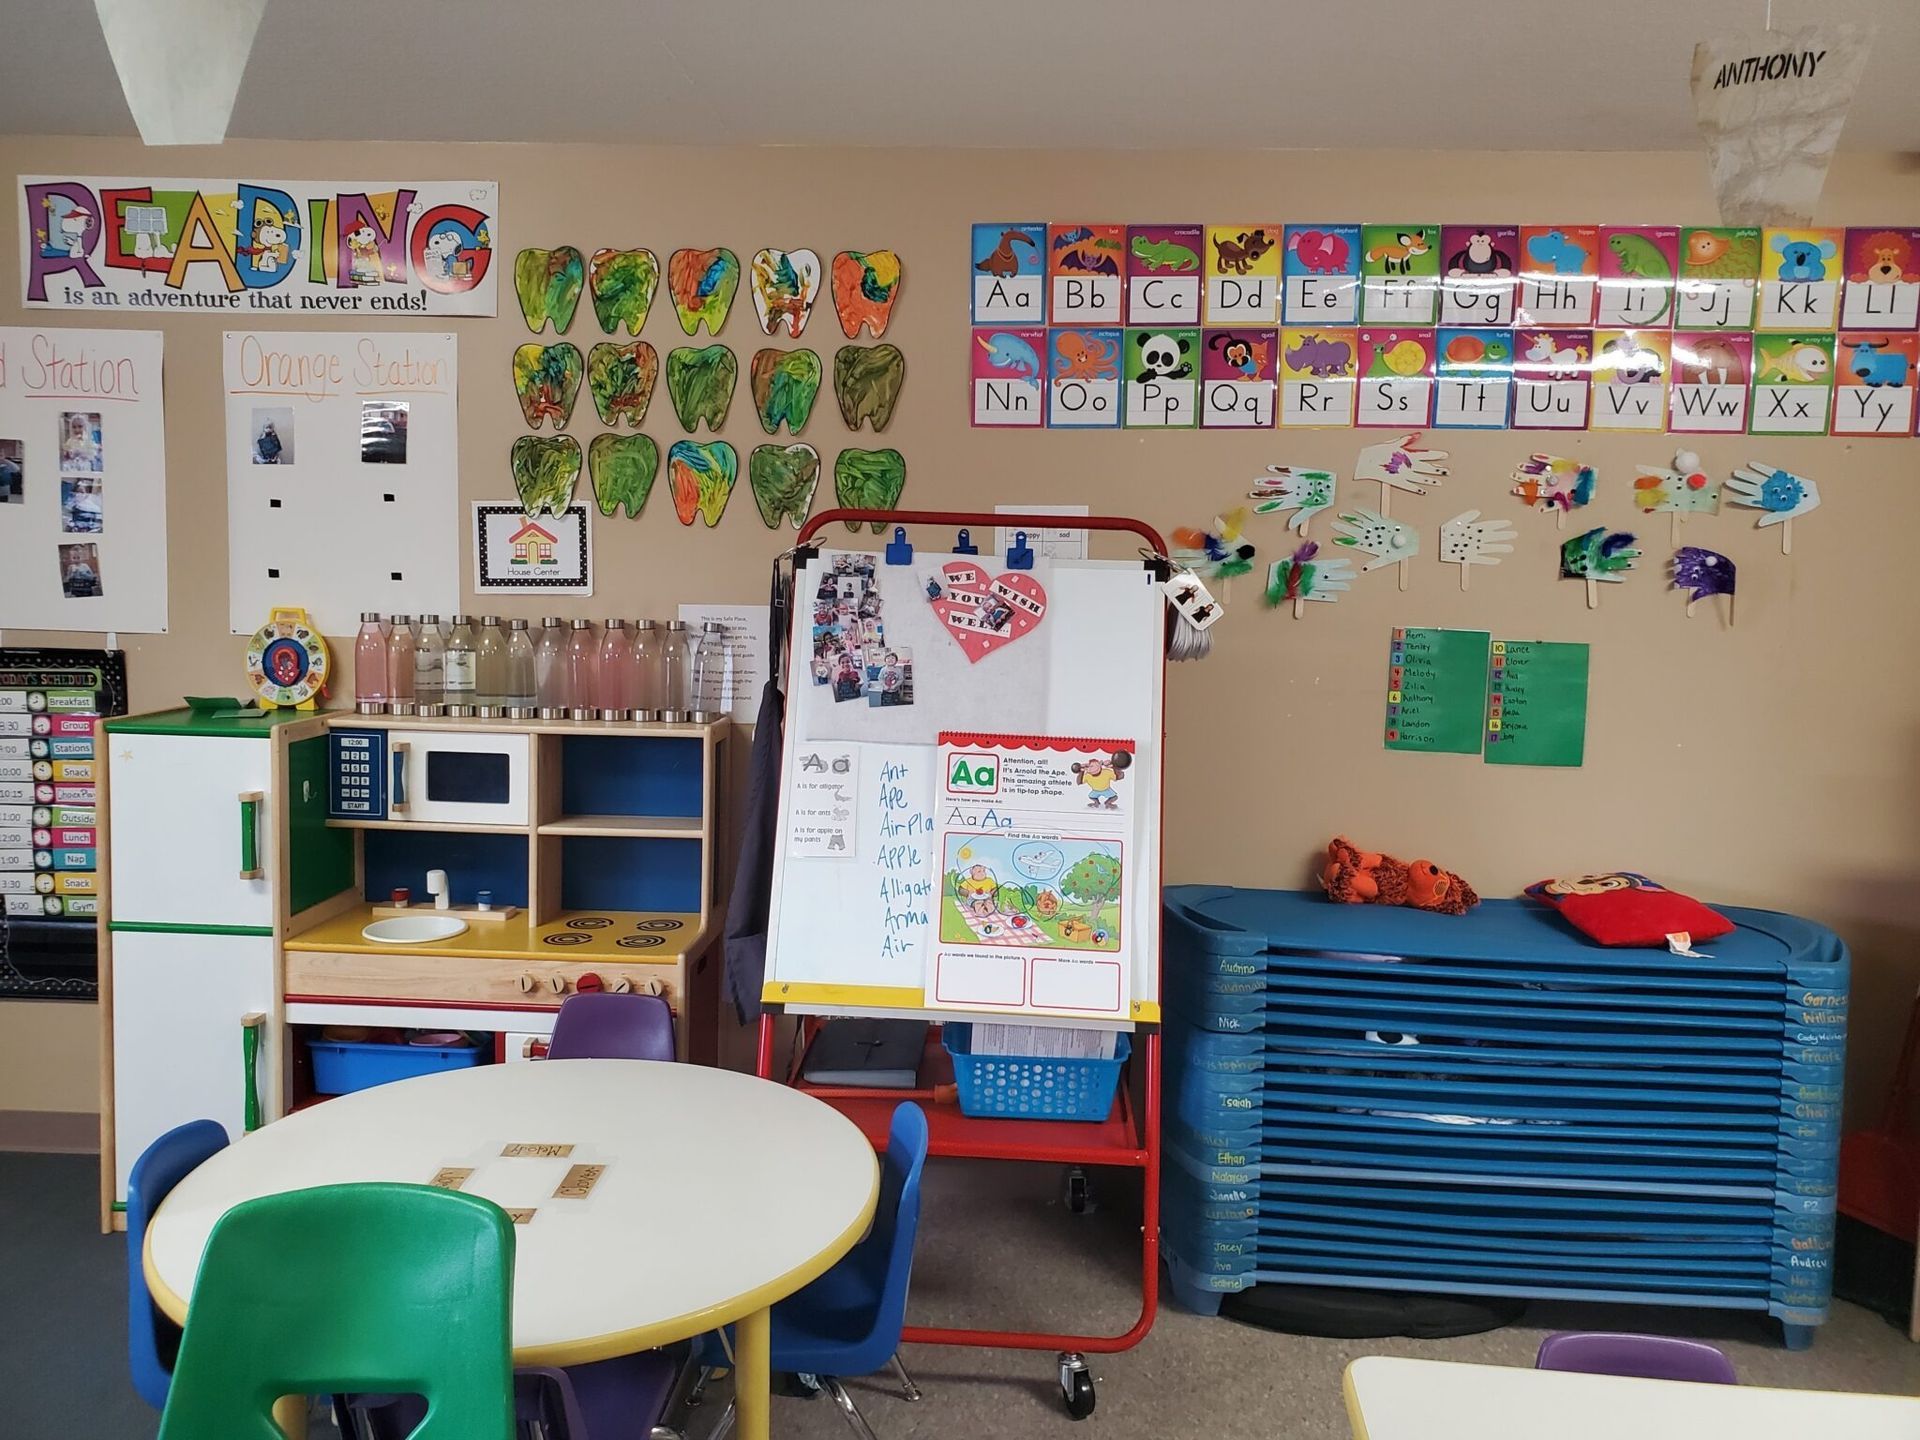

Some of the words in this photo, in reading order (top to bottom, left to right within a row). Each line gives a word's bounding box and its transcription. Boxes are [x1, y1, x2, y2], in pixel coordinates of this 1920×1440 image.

[1713, 50, 1827, 90] ANTHONY
[1333, 226, 1359, 235] elephant
[1496, 229, 1516, 238] gorilla
[25, 181, 493, 303] READING
[64, 286, 84, 305] is
[88, 290, 121, 306] an
[128, 288, 241, 309] adventure
[248, 289, 293, 310] that
[299, 294, 362, 311] never
[369, 289, 428, 311] ends!
[1020, 330, 1044, 338] narwhal
[1178, 330, 1197, 340] panda
[1260, 330, 1276, 340] quail
[1418, 331, 1432, 339] snail
[22, 334, 140, 395] Station
[239, 335, 343, 402] Orange
[353, 338, 450, 388] Station
[507, 567, 531, 576] House
[533, 567, 560, 576] Center
[948, 572, 975, 583] WE
[950, 591, 985, 605] YOU
[998, 584, 1041, 613] WISH
[1506, 643, 1530, 654] Lance
[1405, 654, 1432, 666] Olivia
[1505, 657, 1529, 666] Clover
[40, 673, 95, 685] SCHEDULE
[1403, 667, 1436, 680] Melody
[49, 698, 90, 706] Breakfast
[1402, 694, 1434, 704] Anthony
[62, 721, 90, 731] Group
[1402, 719, 1430, 728] Landon
[1400, 732, 1435, 743] Harrison
[55, 744, 91, 753] Stations
[1003, 757, 1036, 766] Attention,
[1037, 758, 1049, 766] all!
[64, 768, 90, 777] Snack
[879, 760, 909, 783] Ant
[951, 760, 995, 787] Aa
[1003, 767, 1013, 775] It's
[1014, 767, 1037, 776] Arnold
[1039, 768, 1050, 776] the
[1051, 769, 1068, 778] Ape.
[819, 783, 845, 791] alligator
[1003, 777, 1015, 785] This
[1016, 777, 1047, 787] amazing
[1048, 779, 1073, 787] athlete
[879, 783, 909, 810] Ape
[1017, 787, 1040, 795] tip-top
[1041, 788, 1065, 796] shape.
[61, 814, 95, 823] Outside
[64, 833, 90, 842] Lunch
[67, 855, 85, 865] Nap
[876, 844, 922, 871] Apple
[2, 880, 21, 888] 3:30
[64, 879, 90, 887] Snack
[10, 901, 29, 910] 5:00
[72, 901, 95, 912] Gym
[881, 935, 915, 959] Air
[1218, 1016, 1241, 1029] Nick
[1220, 1094, 1252, 1109] Isaiah
[510, 1144, 562, 1156] Melody
[1217, 1152, 1246, 1166] Ethan
[560, 1166, 601, 1197] Clover
[1214, 1242, 1243, 1256] Jacey
